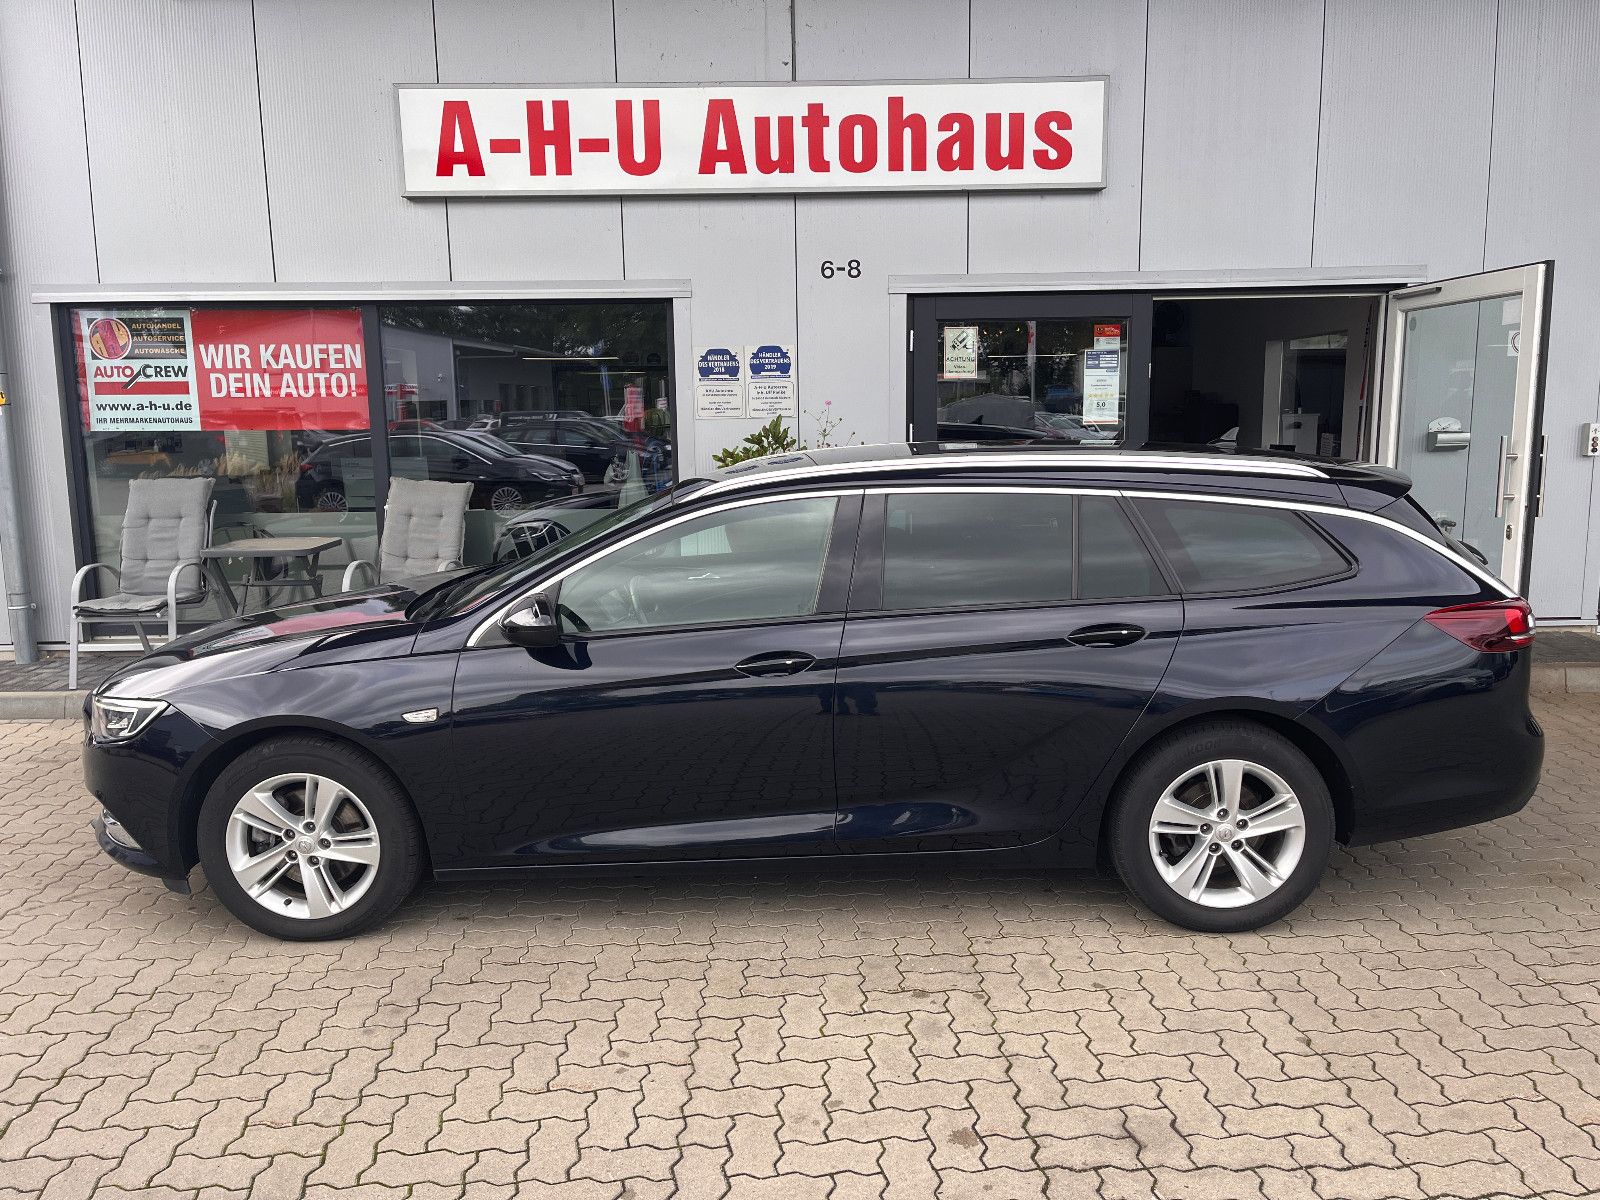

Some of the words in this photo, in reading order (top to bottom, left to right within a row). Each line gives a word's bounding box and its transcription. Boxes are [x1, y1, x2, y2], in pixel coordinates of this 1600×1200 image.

[436, 99, 662, 177] A-H-U
[698, 96, 1073, 175] Autohaus
[820, 260, 863, 279] 6-8
[199, 344, 251, 369] WIR
[261, 344, 362, 369] KAUFEN
[94, 365, 135, 378] AUTO
[141, 364, 188, 379] CREW
[209, 372, 271, 398] DEIN
[279, 373, 358, 398] AUTO!
[96, 401, 192, 411] www.a-h-u.de
